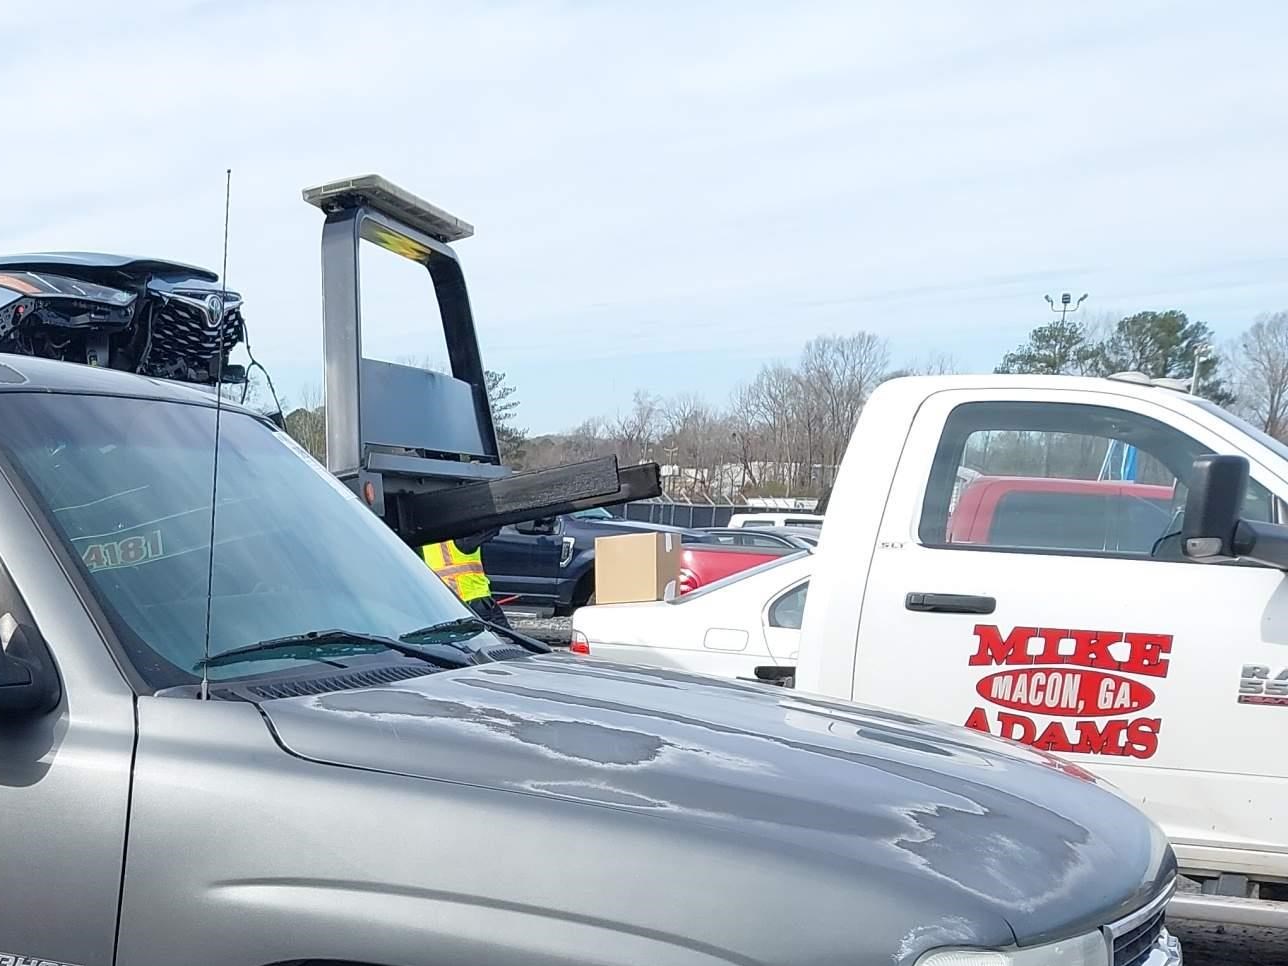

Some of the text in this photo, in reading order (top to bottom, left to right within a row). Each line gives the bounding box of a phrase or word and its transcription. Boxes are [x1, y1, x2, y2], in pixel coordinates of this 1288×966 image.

[968, 624, 1174, 678] MIKE
[990, 672, 1139, 713] MACON, GA.
[964, 707, 1162, 759] ADAMS
